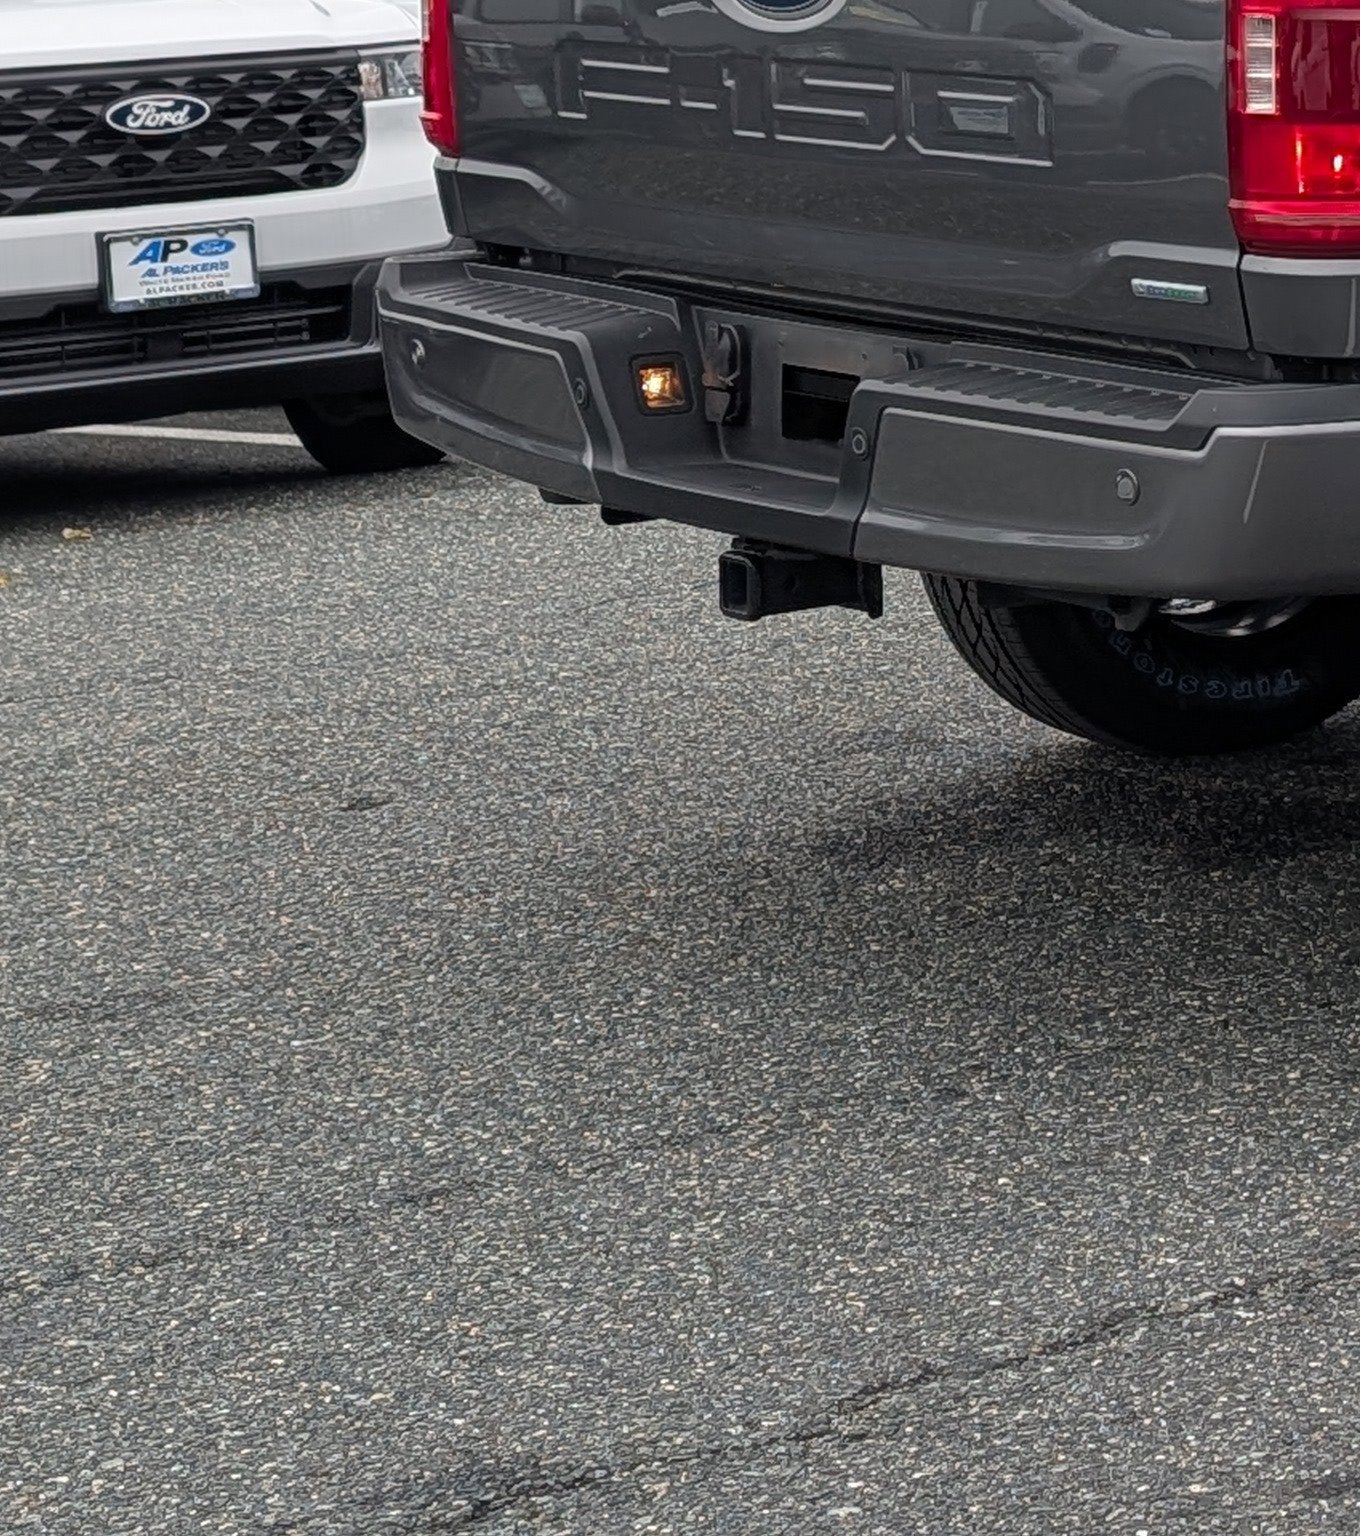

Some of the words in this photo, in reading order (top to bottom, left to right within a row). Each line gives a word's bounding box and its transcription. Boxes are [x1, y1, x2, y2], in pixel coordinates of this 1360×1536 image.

[126, 100, 191, 128] Ford
[555, 39, 1055, 167] F-150
[128, 239, 188, 266] AP
